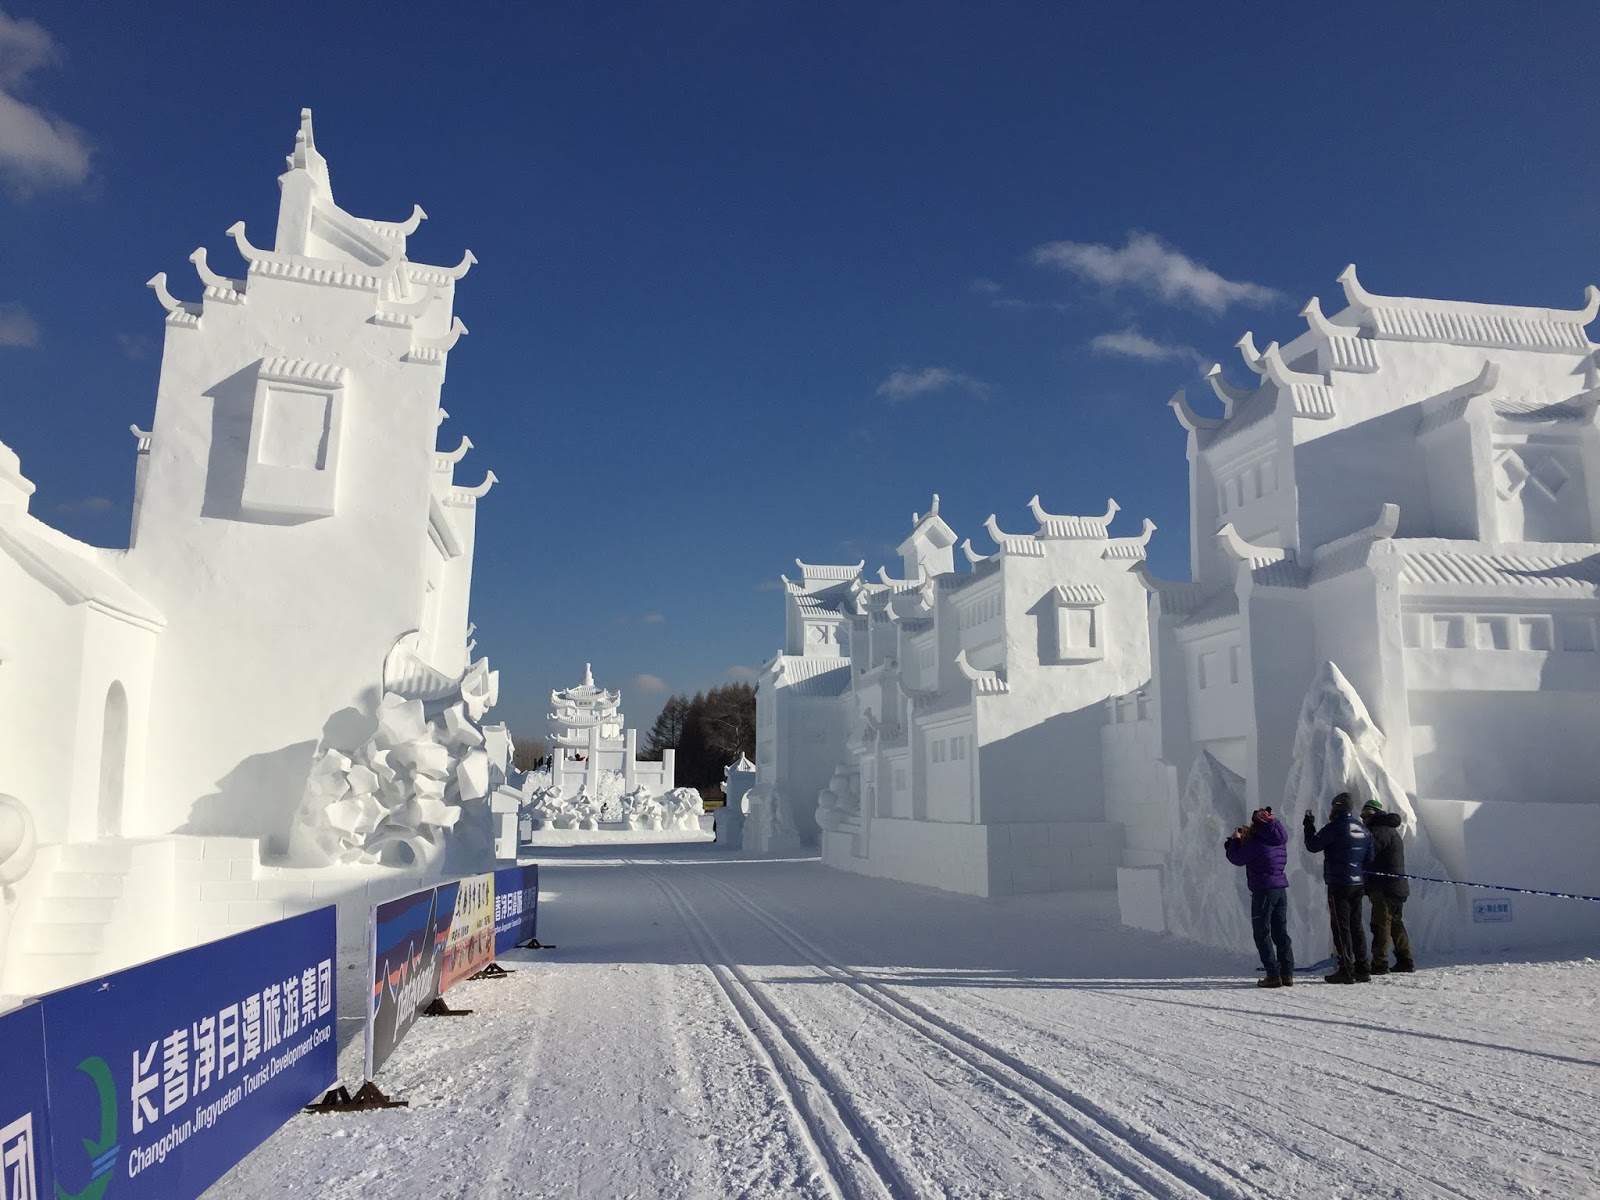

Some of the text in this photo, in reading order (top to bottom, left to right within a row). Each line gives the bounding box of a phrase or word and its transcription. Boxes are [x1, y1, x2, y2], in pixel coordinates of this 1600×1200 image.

[128, 1025, 331, 1178] Changchun Jingyuetan Tourist Development Group
[131, 958, 331, 1134] 长春净月潭旅游集团
